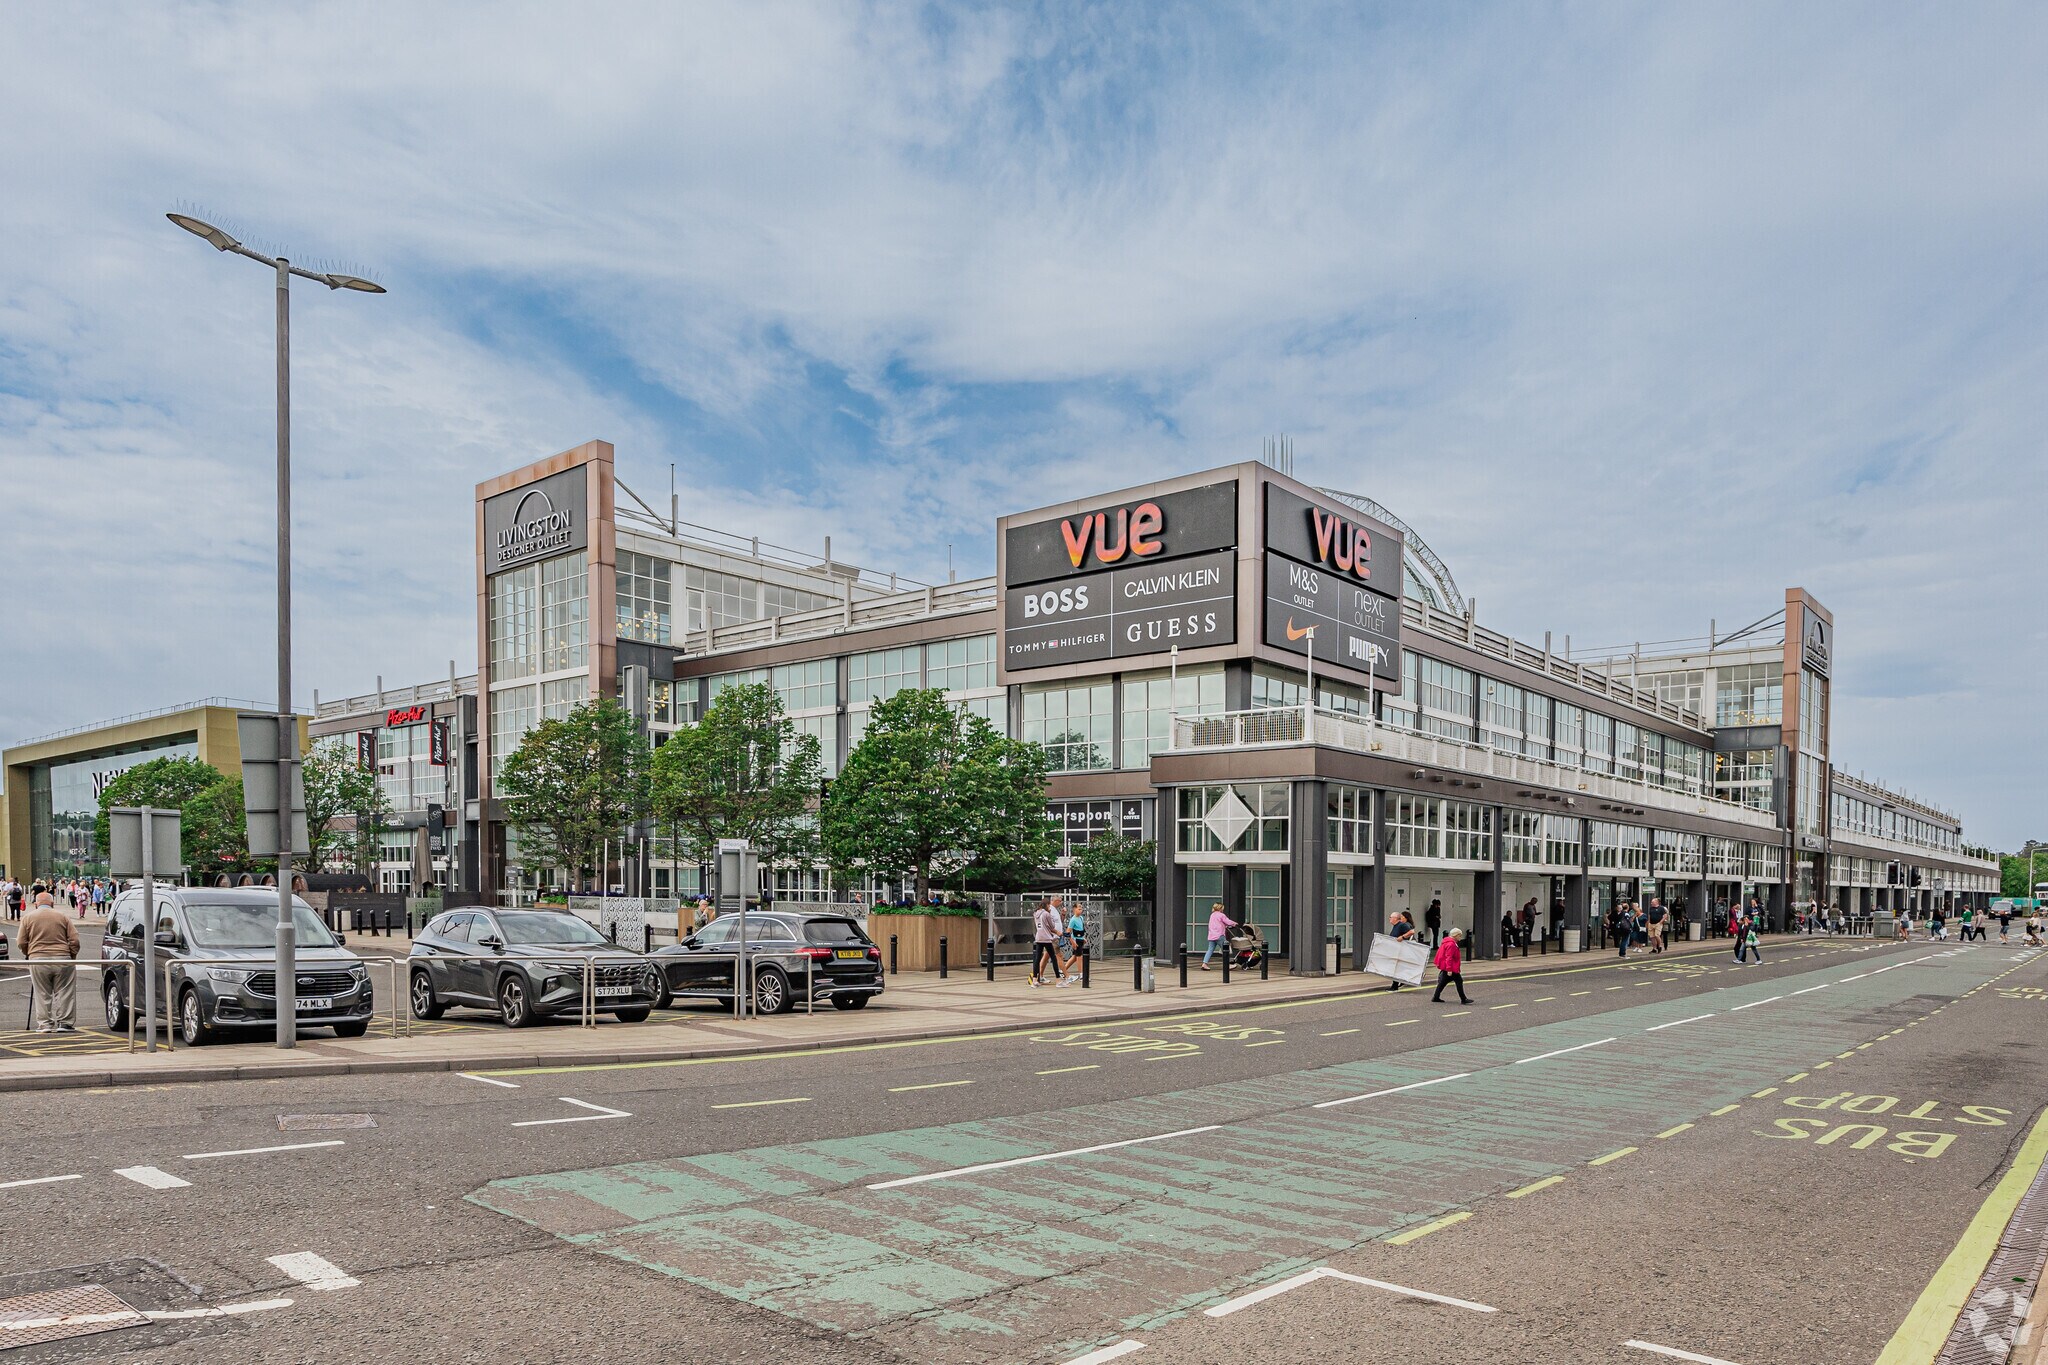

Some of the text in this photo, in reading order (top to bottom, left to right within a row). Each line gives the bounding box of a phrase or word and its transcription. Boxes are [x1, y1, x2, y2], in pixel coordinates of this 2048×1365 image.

[497, 509, 571, 548] LIVINGSTON
[497, 530, 570, 562] DESIGNER OUTLET
[1124, 567, 1220, 598] CALVIN KLEIN
[1290, 564, 1318, 594] M&S
[1024, 585, 1089, 618] BOSS
[1293, 594, 1315, 608] OUTLET
[1354, 590, 1385, 618] next
[1126, 612, 1216, 643] GUESS
[1354, 611, 1385, 633] OUTLET
[1009, 633, 1106, 654] TOMMY HILFIGER
[386, 705, 425, 727] Pizza Hut
[433, 724, 443, 763] Pizza Hut
[1035, 810, 1111, 823] therspoon
[296, 1000, 328, 1008] 74 MLX
[598, 987, 616, 995] ST73
[1029, 1031, 1202, 1054] STOP
[1783, 1092, 2013, 1126] STOP
[1752, 1118, 1959, 1159] BUS
